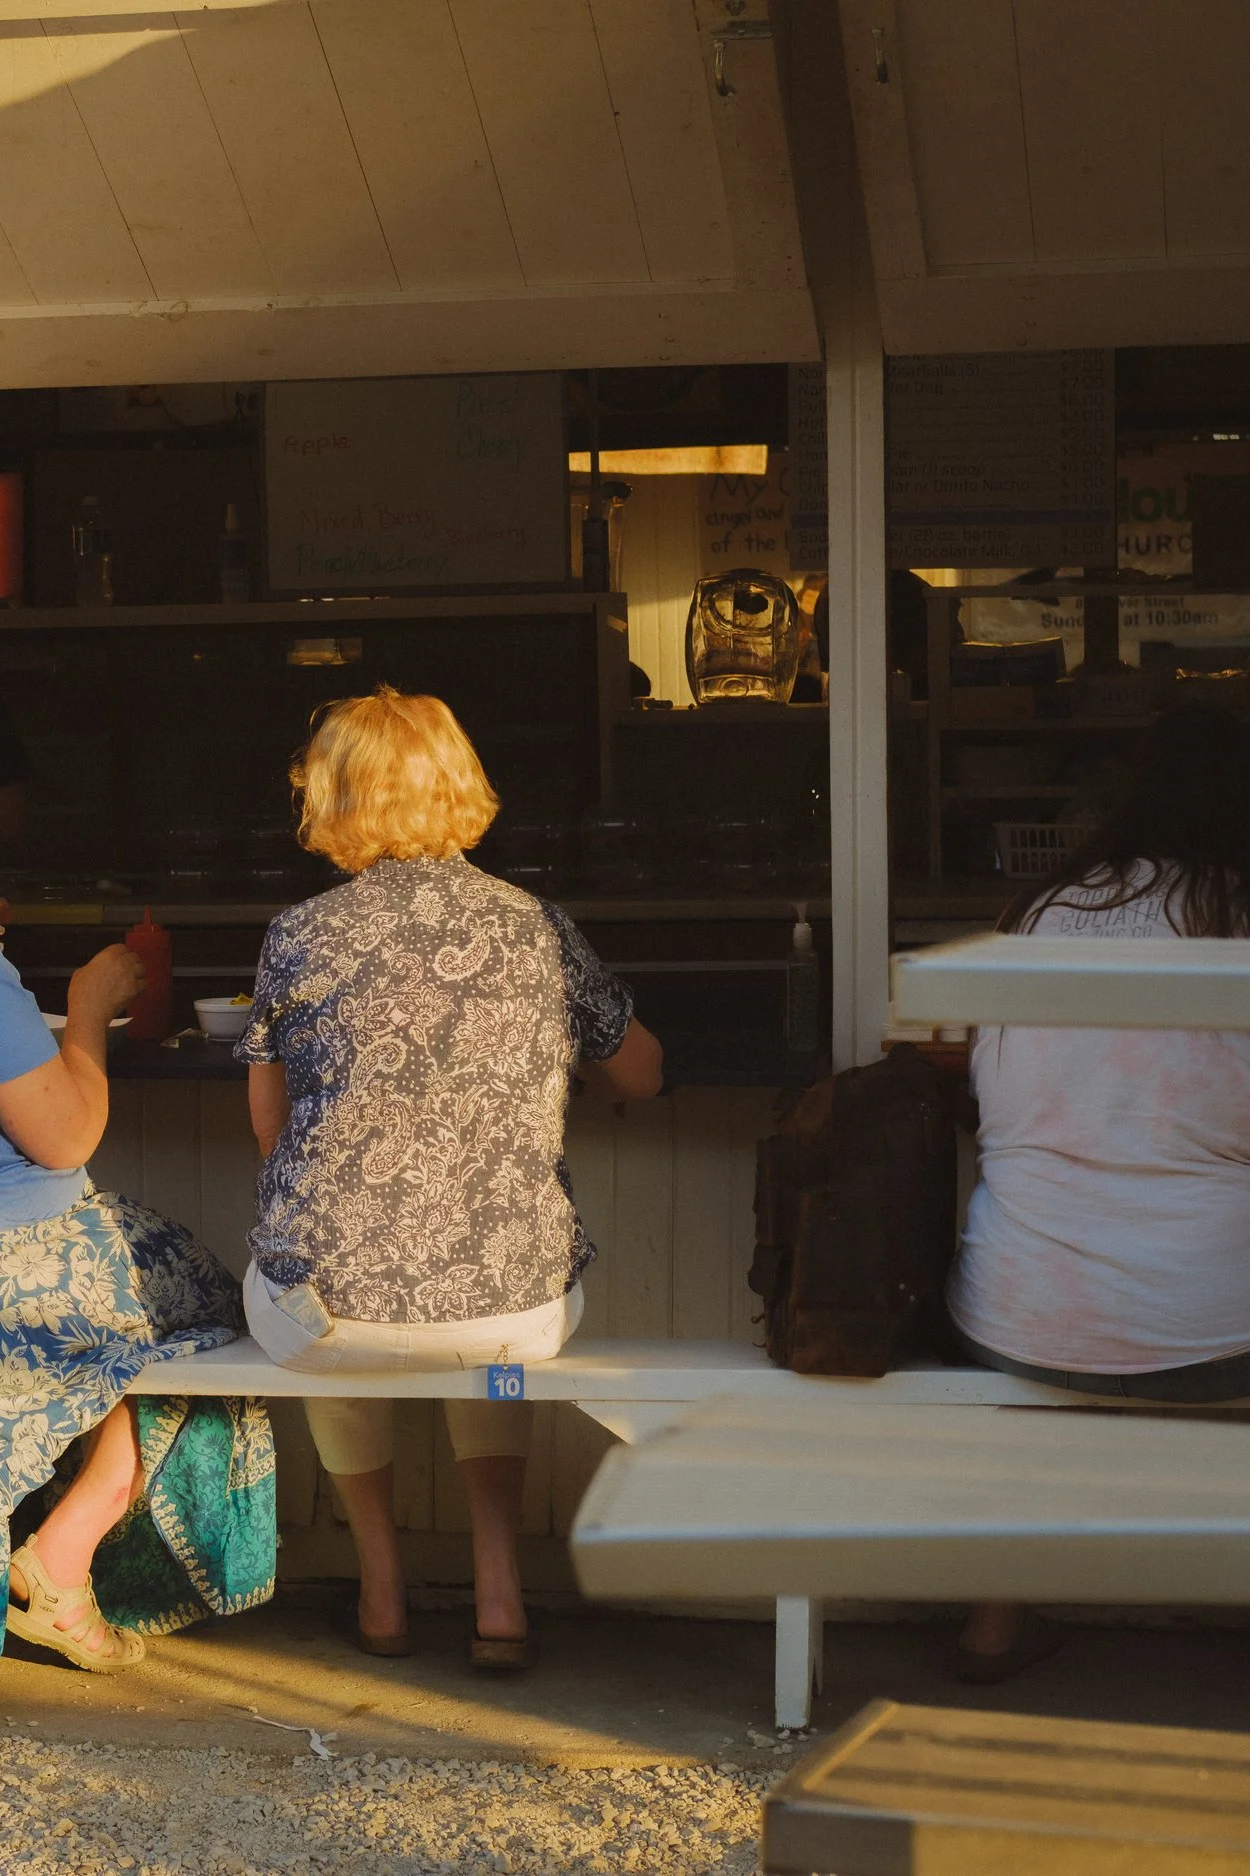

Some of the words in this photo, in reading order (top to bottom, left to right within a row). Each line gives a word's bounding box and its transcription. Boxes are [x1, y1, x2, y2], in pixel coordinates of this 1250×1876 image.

[284, 434, 352, 456] Apple
[710, 474, 768, 506] My
[710, 531, 733, 554] of
[744, 530, 776, 553] the
[1116, 535, 1193, 556] HURC
[1123, 612, 1139, 627] at
[494, 1378, 521, 1397] 10
